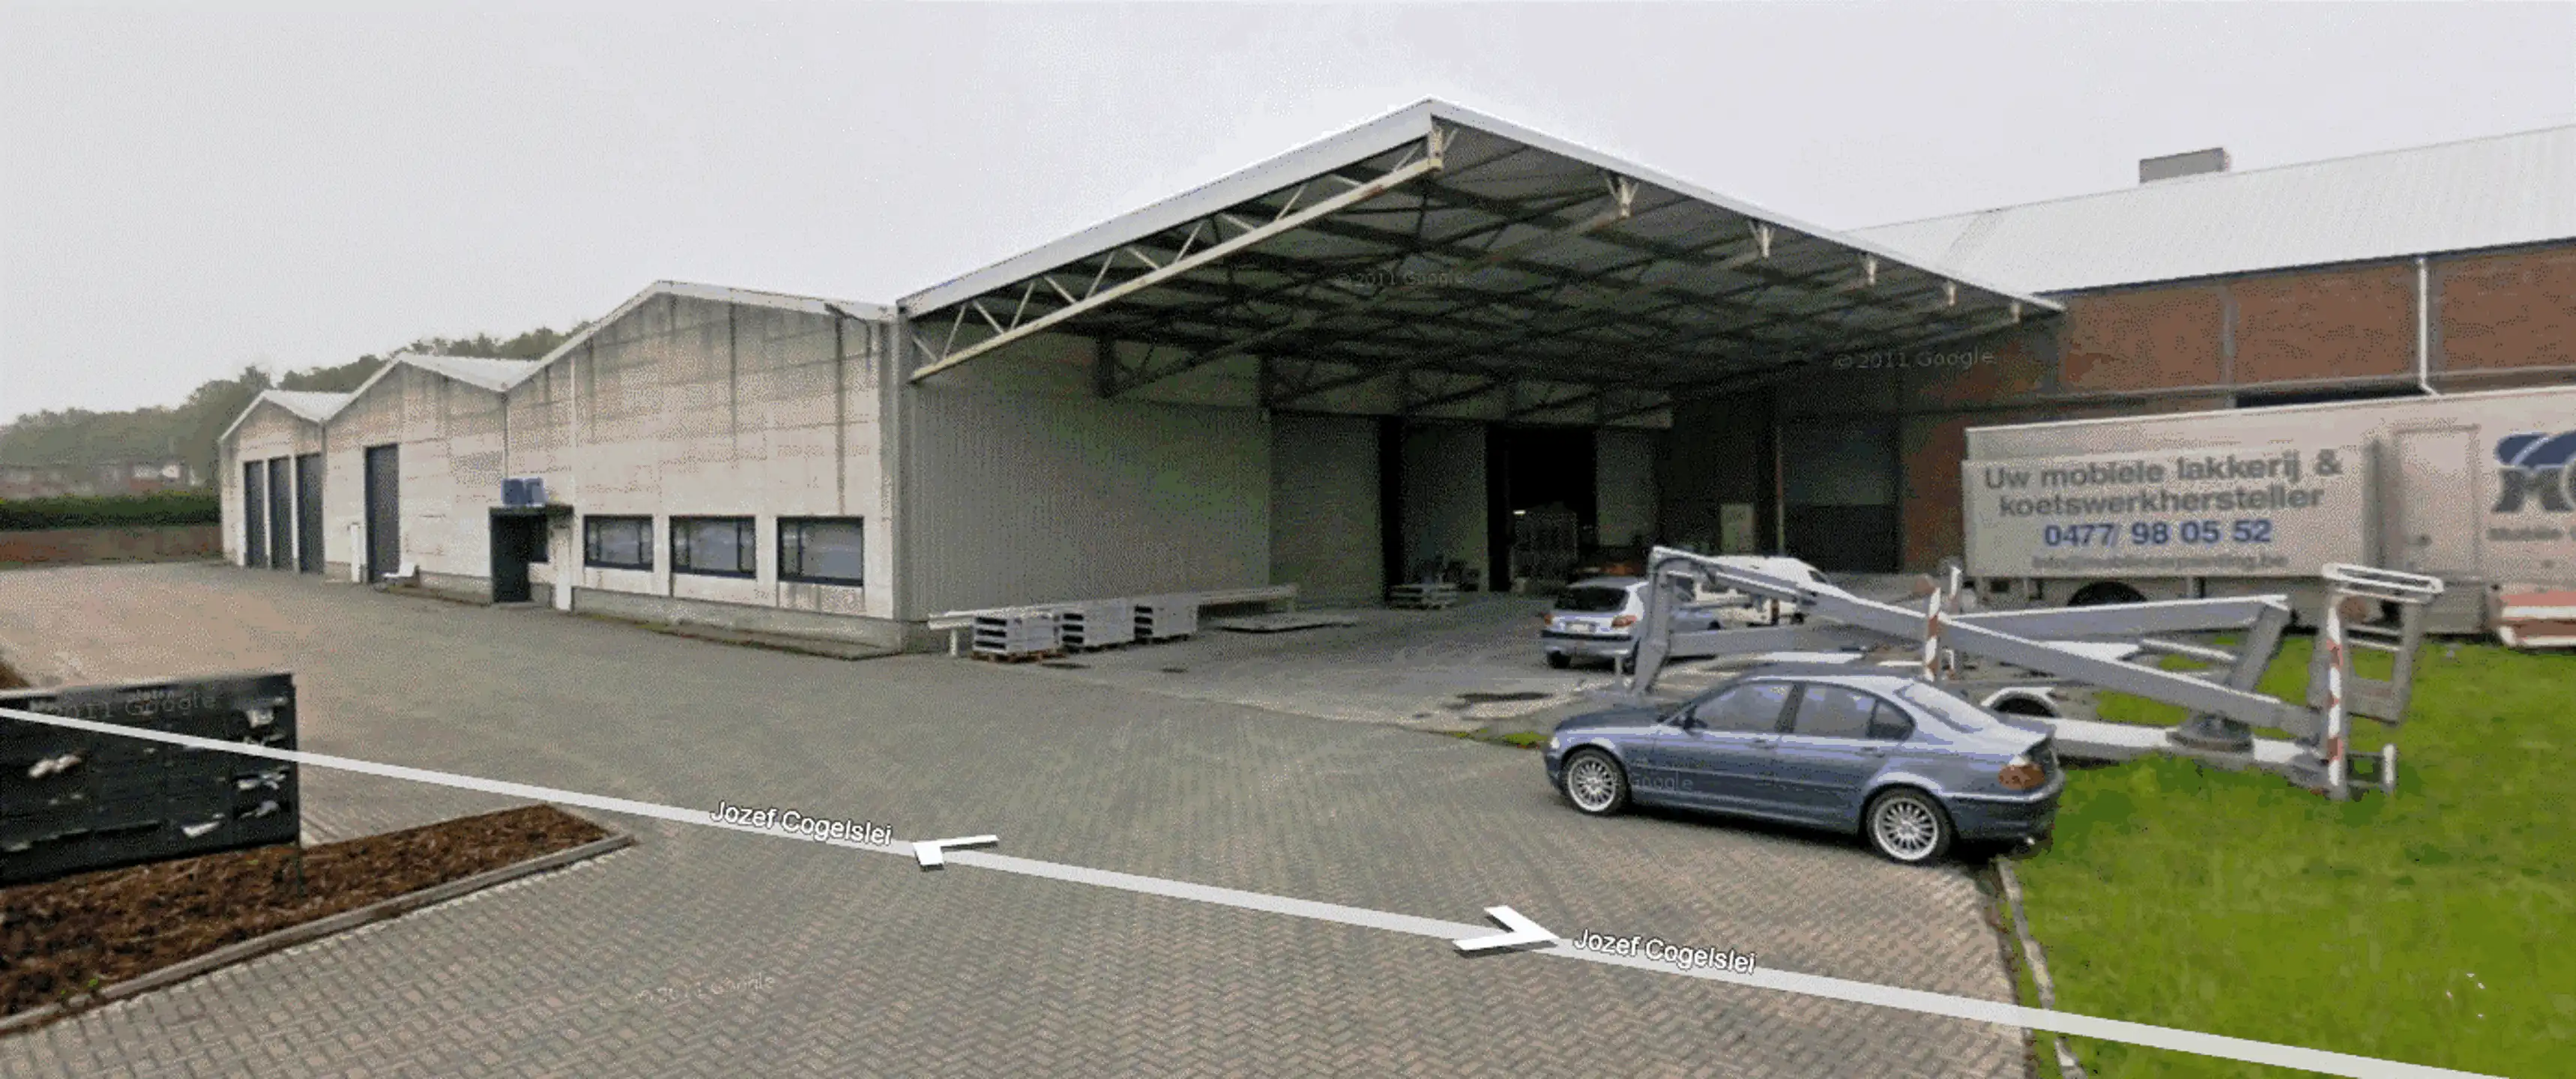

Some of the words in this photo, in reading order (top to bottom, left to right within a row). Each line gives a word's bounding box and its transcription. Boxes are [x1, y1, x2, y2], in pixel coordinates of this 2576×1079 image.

[1983, 467, 2031, 490] Uw
[2039, 460, 2166, 489] mobiele
[2176, 450, 2302, 483] lakkerij
[2314, 450, 2344, 477] &
[1998, 484, 2323, 519] koetswerkhersteller
[2130, 522, 2170, 545] 98
[2180, 521, 2221, 545] 05
[2232, 519, 2272, 543] 52
